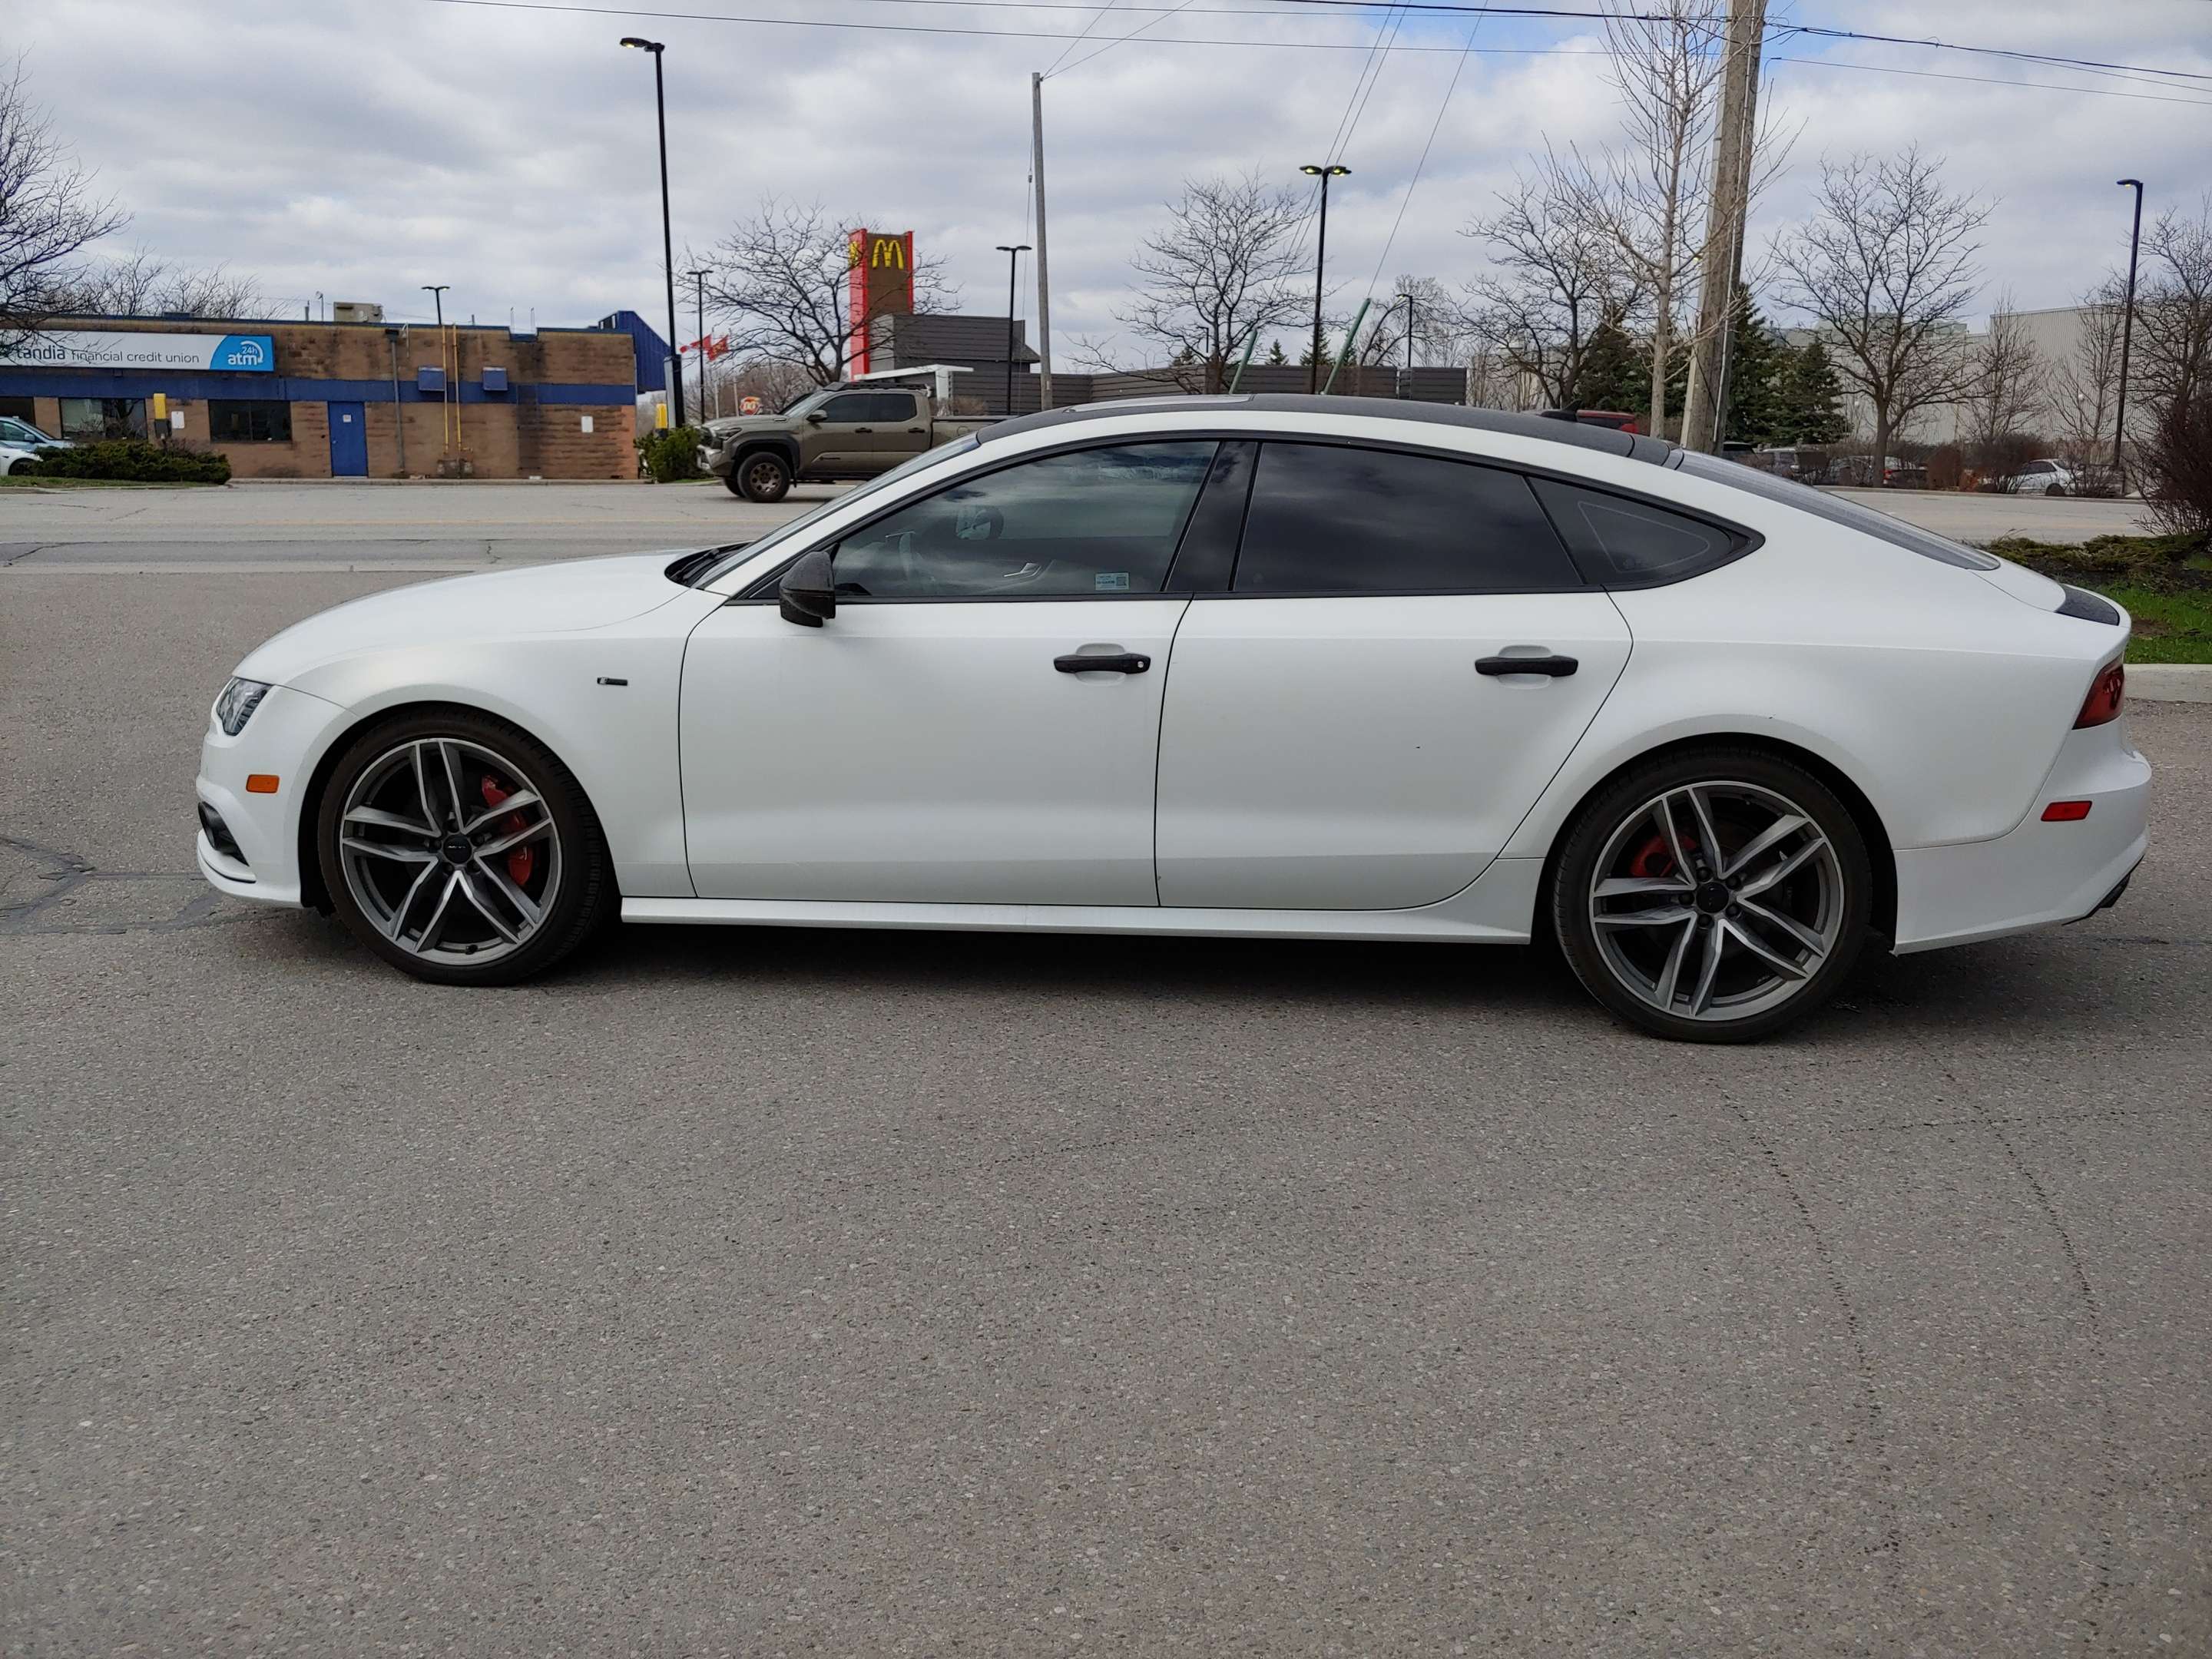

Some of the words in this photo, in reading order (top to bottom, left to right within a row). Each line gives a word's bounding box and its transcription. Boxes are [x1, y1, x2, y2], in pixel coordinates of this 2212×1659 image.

[71, 349, 123, 363] financial
[127, 352, 162, 363] credit
[165, 353, 200, 363] union
[242, 346, 257, 355] 24h
[227, 353, 257, 366] atm
